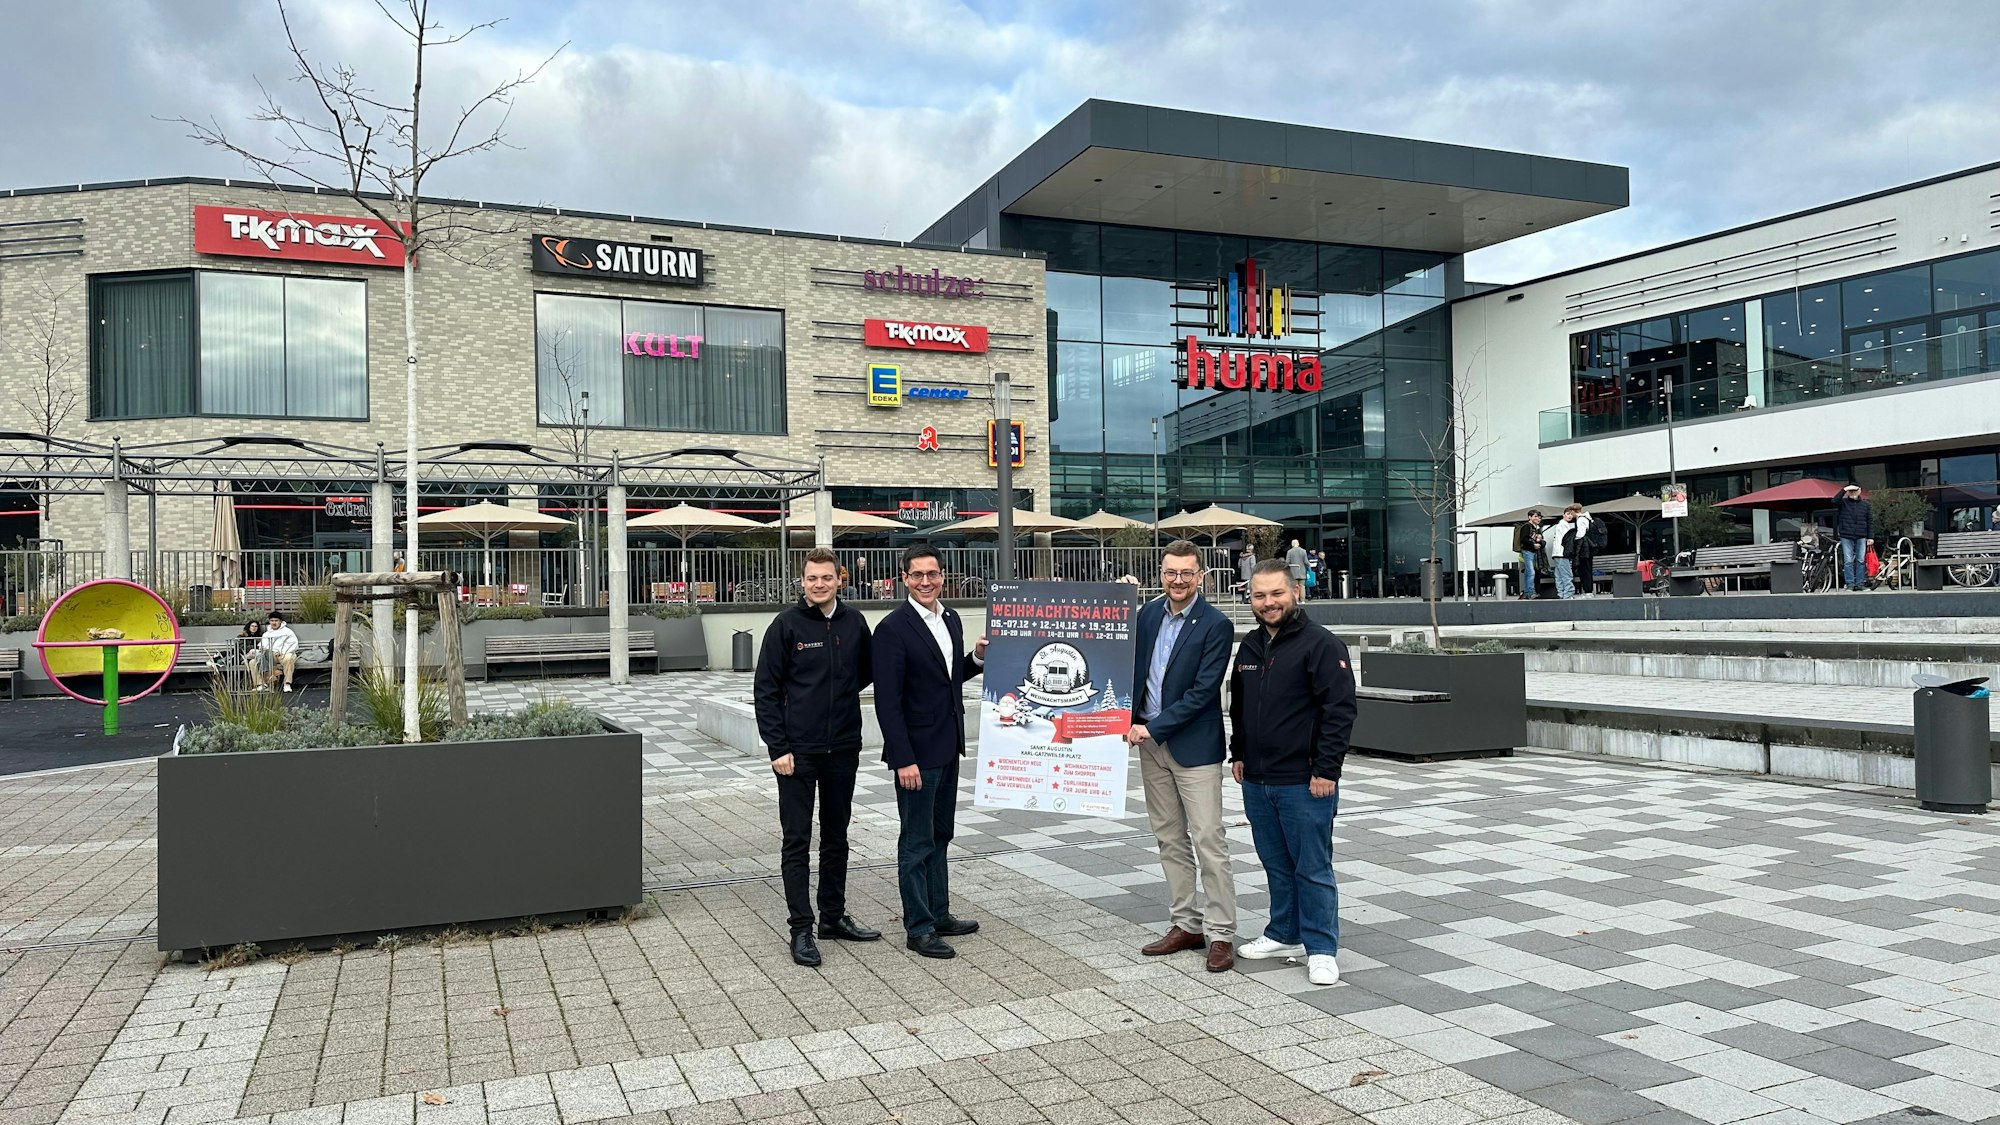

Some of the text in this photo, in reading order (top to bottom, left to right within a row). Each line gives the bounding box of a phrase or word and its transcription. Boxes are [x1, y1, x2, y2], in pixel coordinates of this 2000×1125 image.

[596, 243, 697, 278] SATURN
[624, 331, 703, 359] KULT
[1186, 335, 1322, 391] huma
[908, 387, 968, 400] center
[992, 603, 1130, 620] WEIHNACHTSMARKT
[1066, 631, 1079, 639] UHR
[1049, 644, 1078, 661] Augustin
[1030, 692, 1083, 703] WEIHNACHTSMARKT
